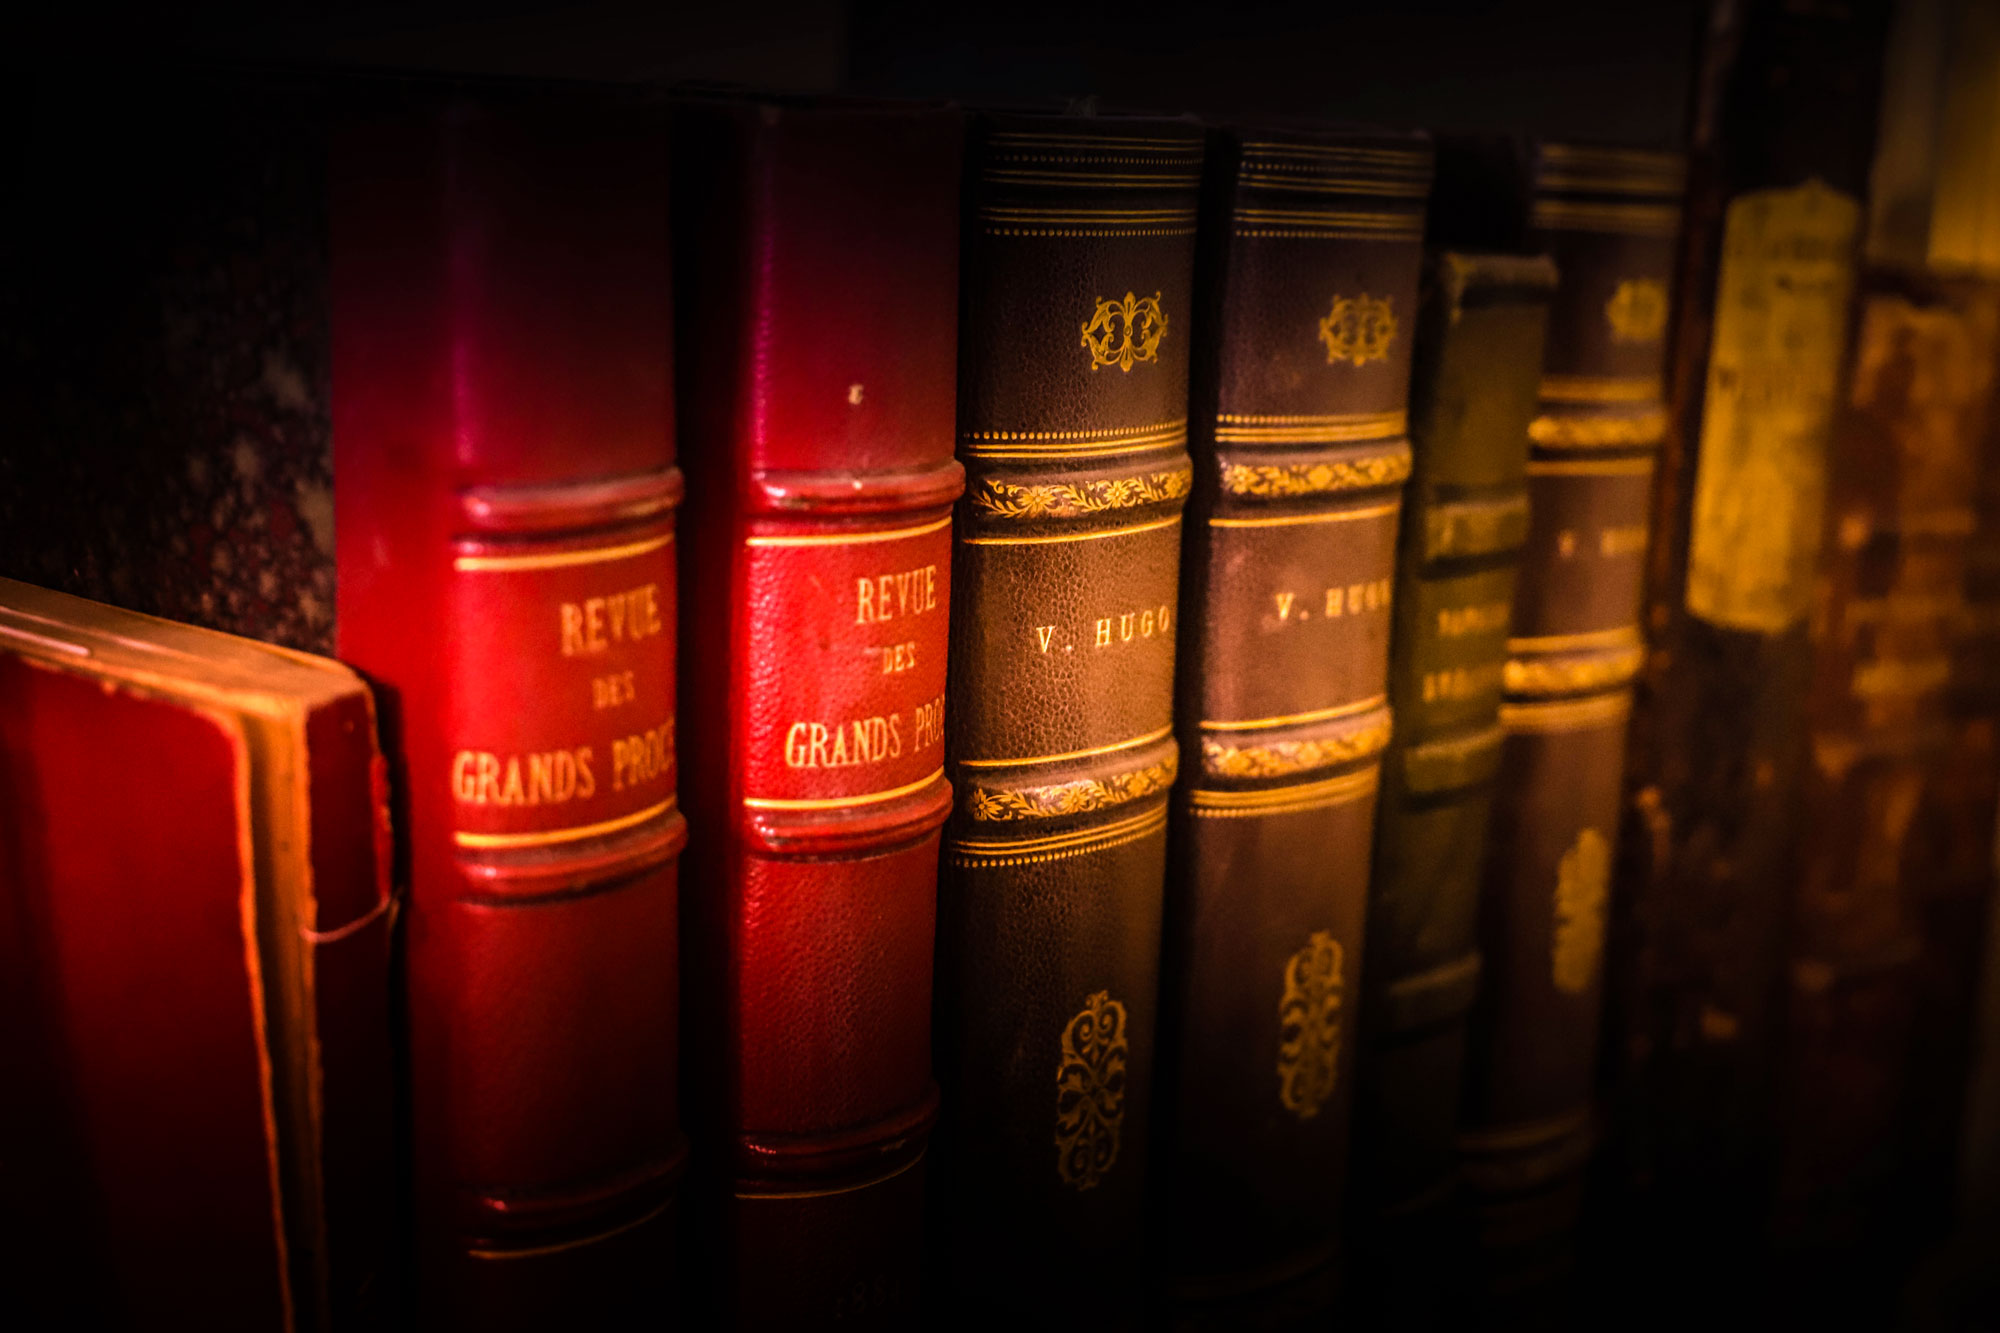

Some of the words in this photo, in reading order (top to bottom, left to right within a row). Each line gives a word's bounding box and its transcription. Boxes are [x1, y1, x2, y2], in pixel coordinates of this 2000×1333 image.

[560, 582, 661, 657] REVUE
[856, 564, 937, 625] REVUE
[1036, 624, 1072, 653] V.
[1095, 605, 1170, 649] HUGO
[882, 641, 915, 675] DES
[785, 713, 901, 768] GRANDS
[452, 748, 596, 806] GRANDS
